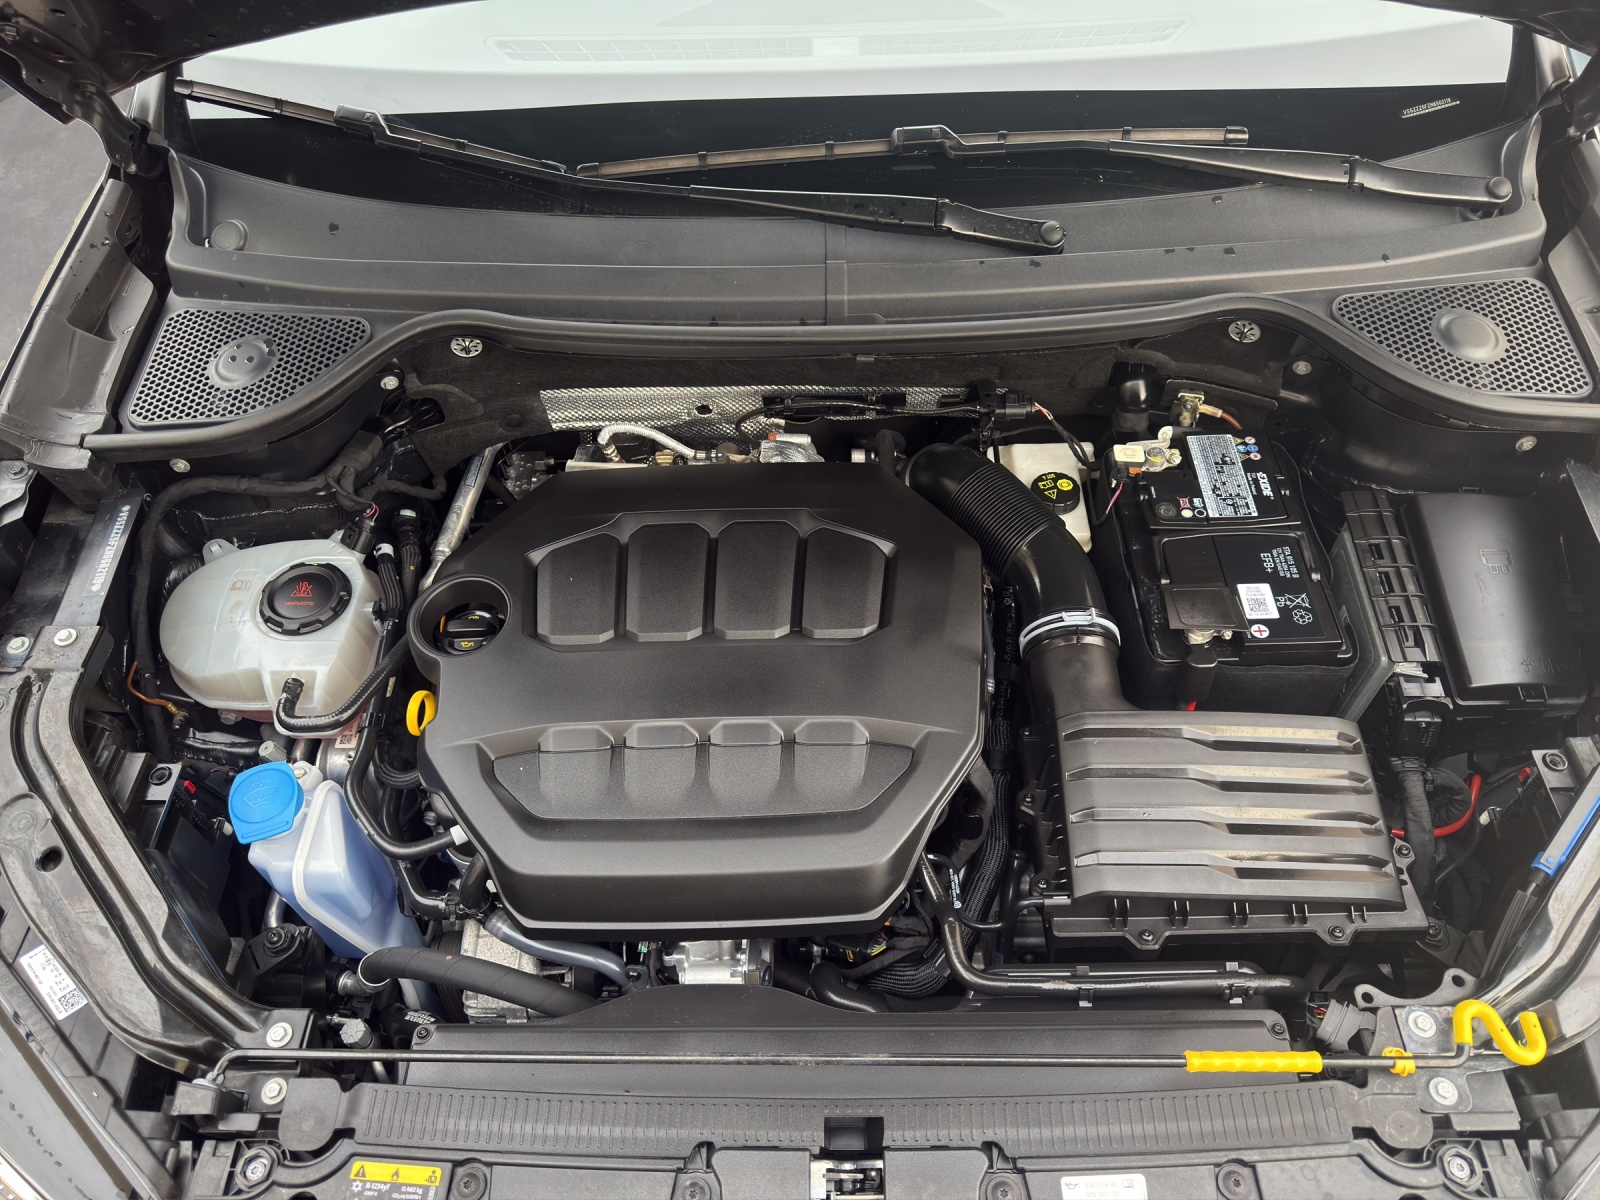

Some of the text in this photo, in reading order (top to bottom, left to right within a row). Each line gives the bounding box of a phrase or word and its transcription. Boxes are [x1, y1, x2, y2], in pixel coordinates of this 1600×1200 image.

[1256, 471, 1274, 497] EXIDE
[1275, 596, 1285, 608] Pb
[365, 1182, 391, 1192] R-1234yf
